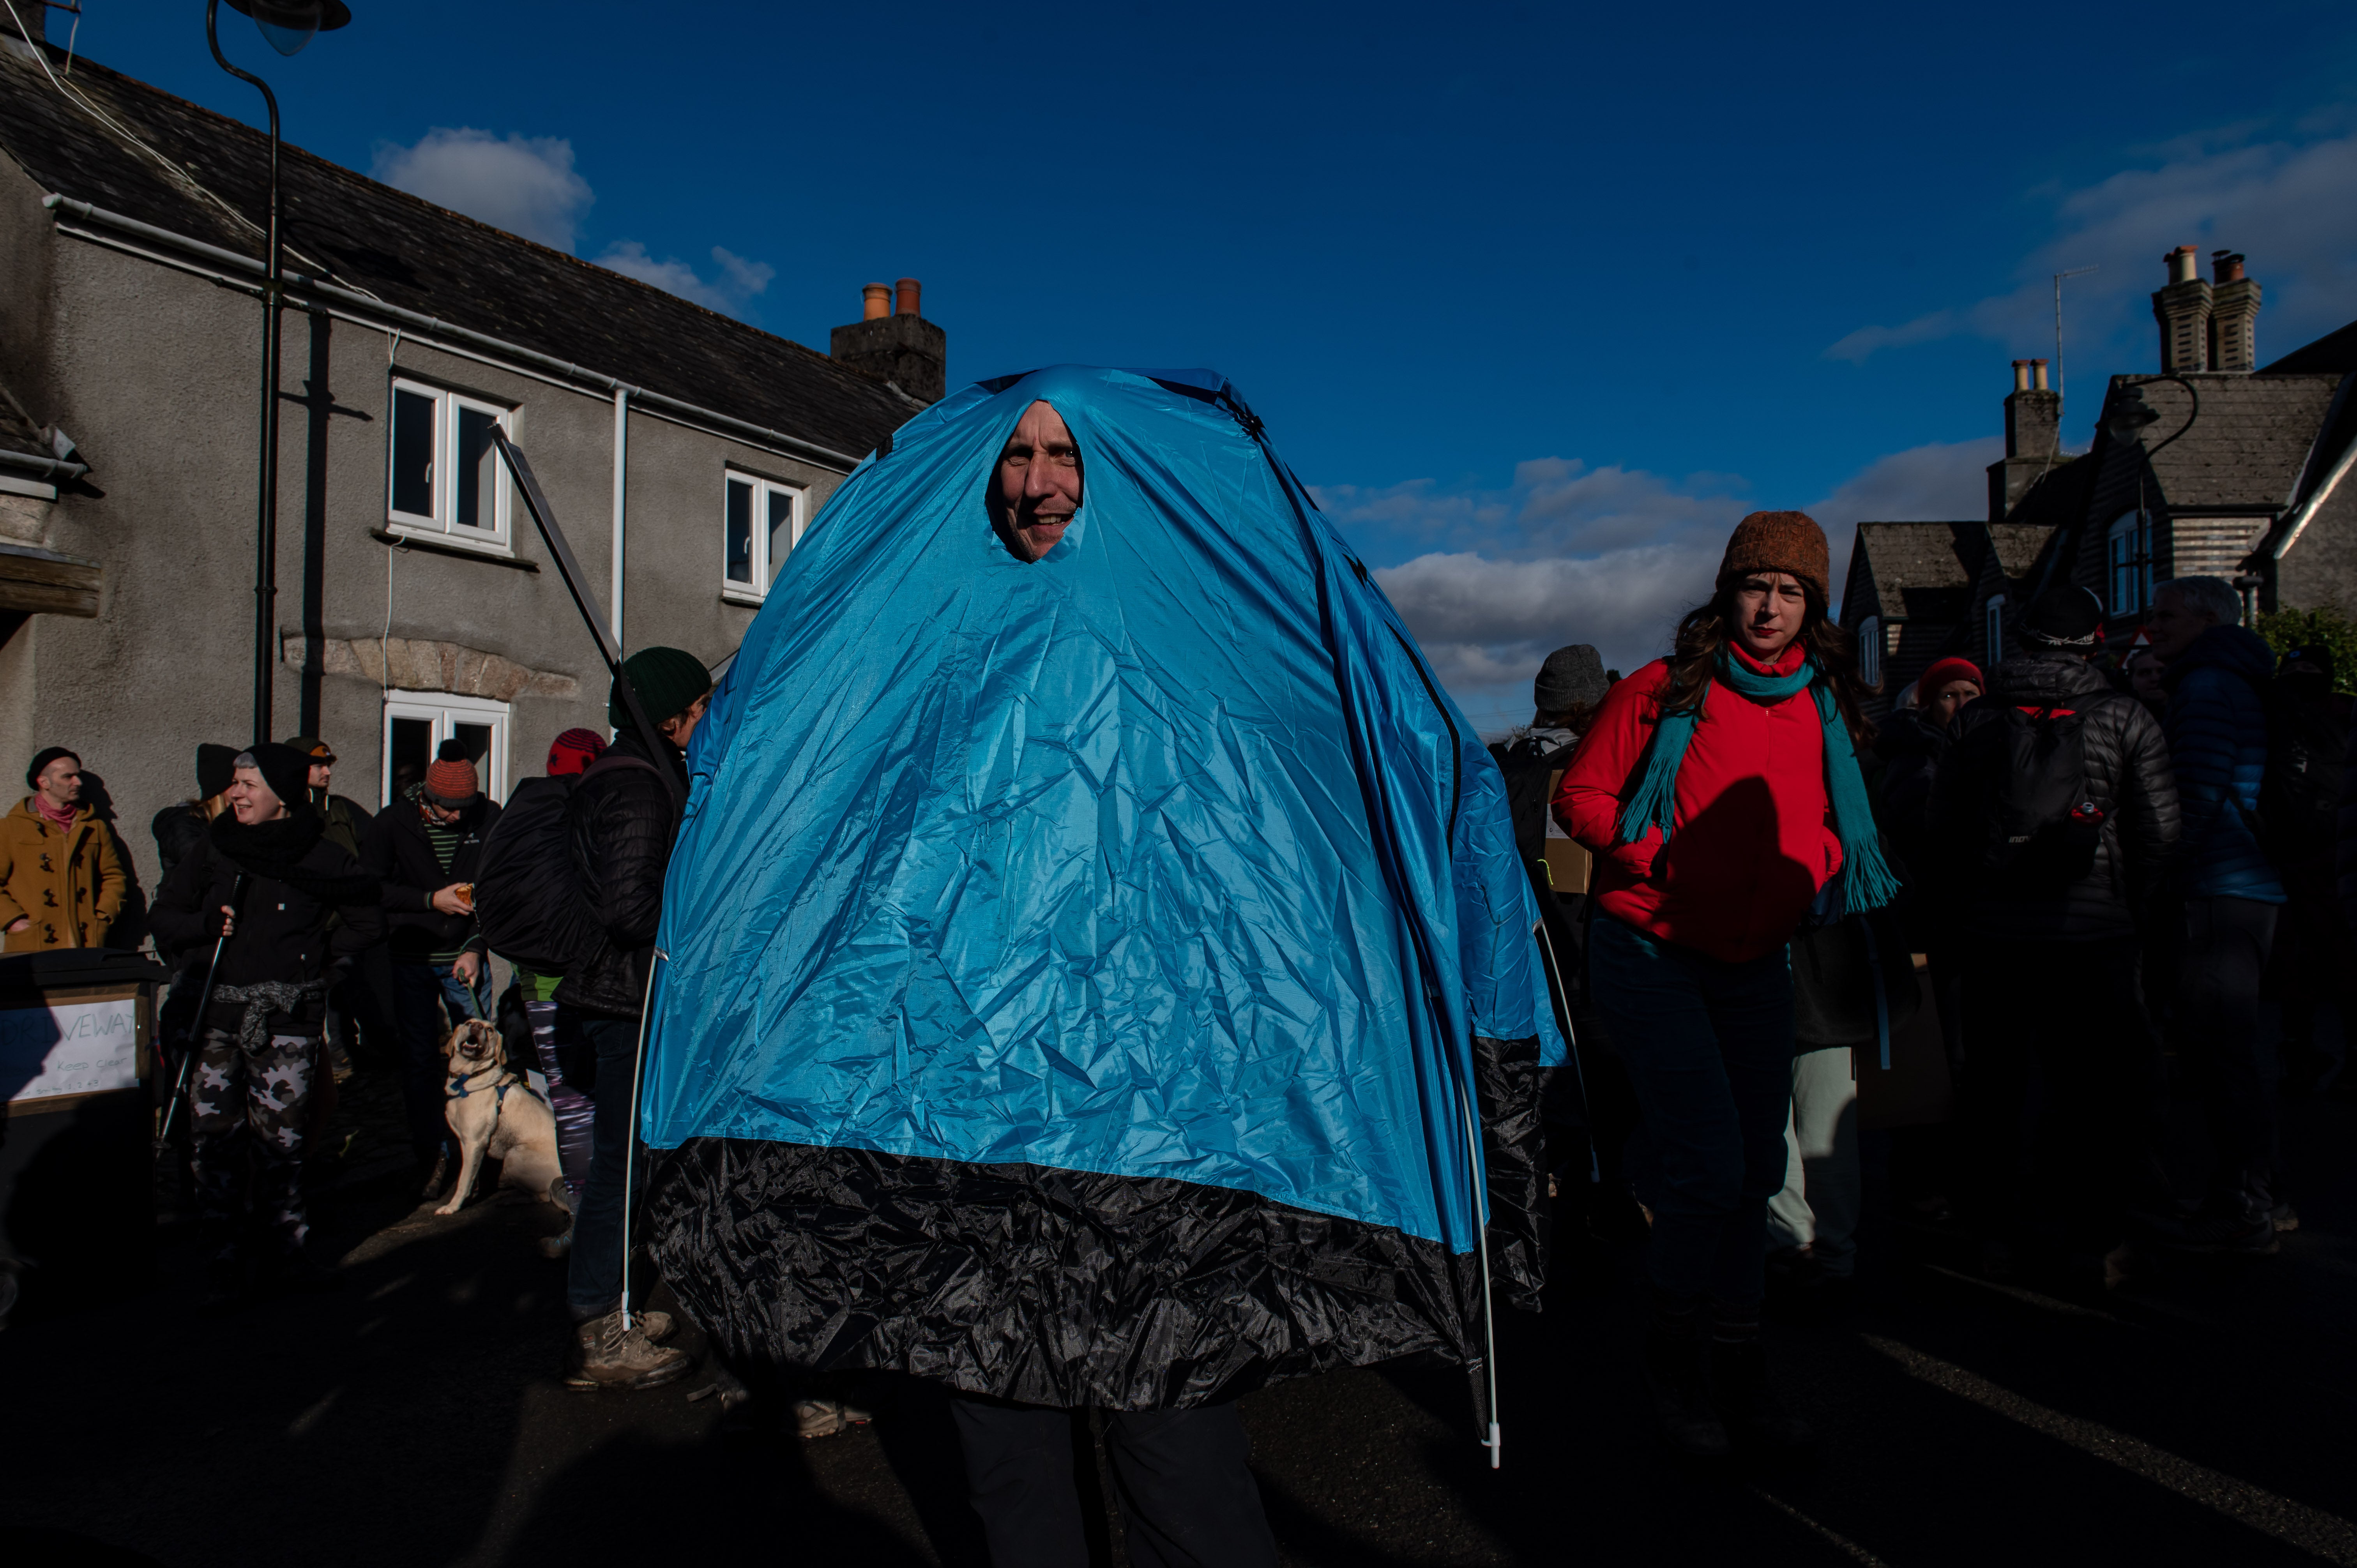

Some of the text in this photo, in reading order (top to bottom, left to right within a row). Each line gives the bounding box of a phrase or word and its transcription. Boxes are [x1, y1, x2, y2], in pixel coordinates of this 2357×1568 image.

[0, 1013, 134, 1045] DRIVEWAY
[57, 1060, 89, 1071] Keep
[96, 1057, 127, 1068] Clear
